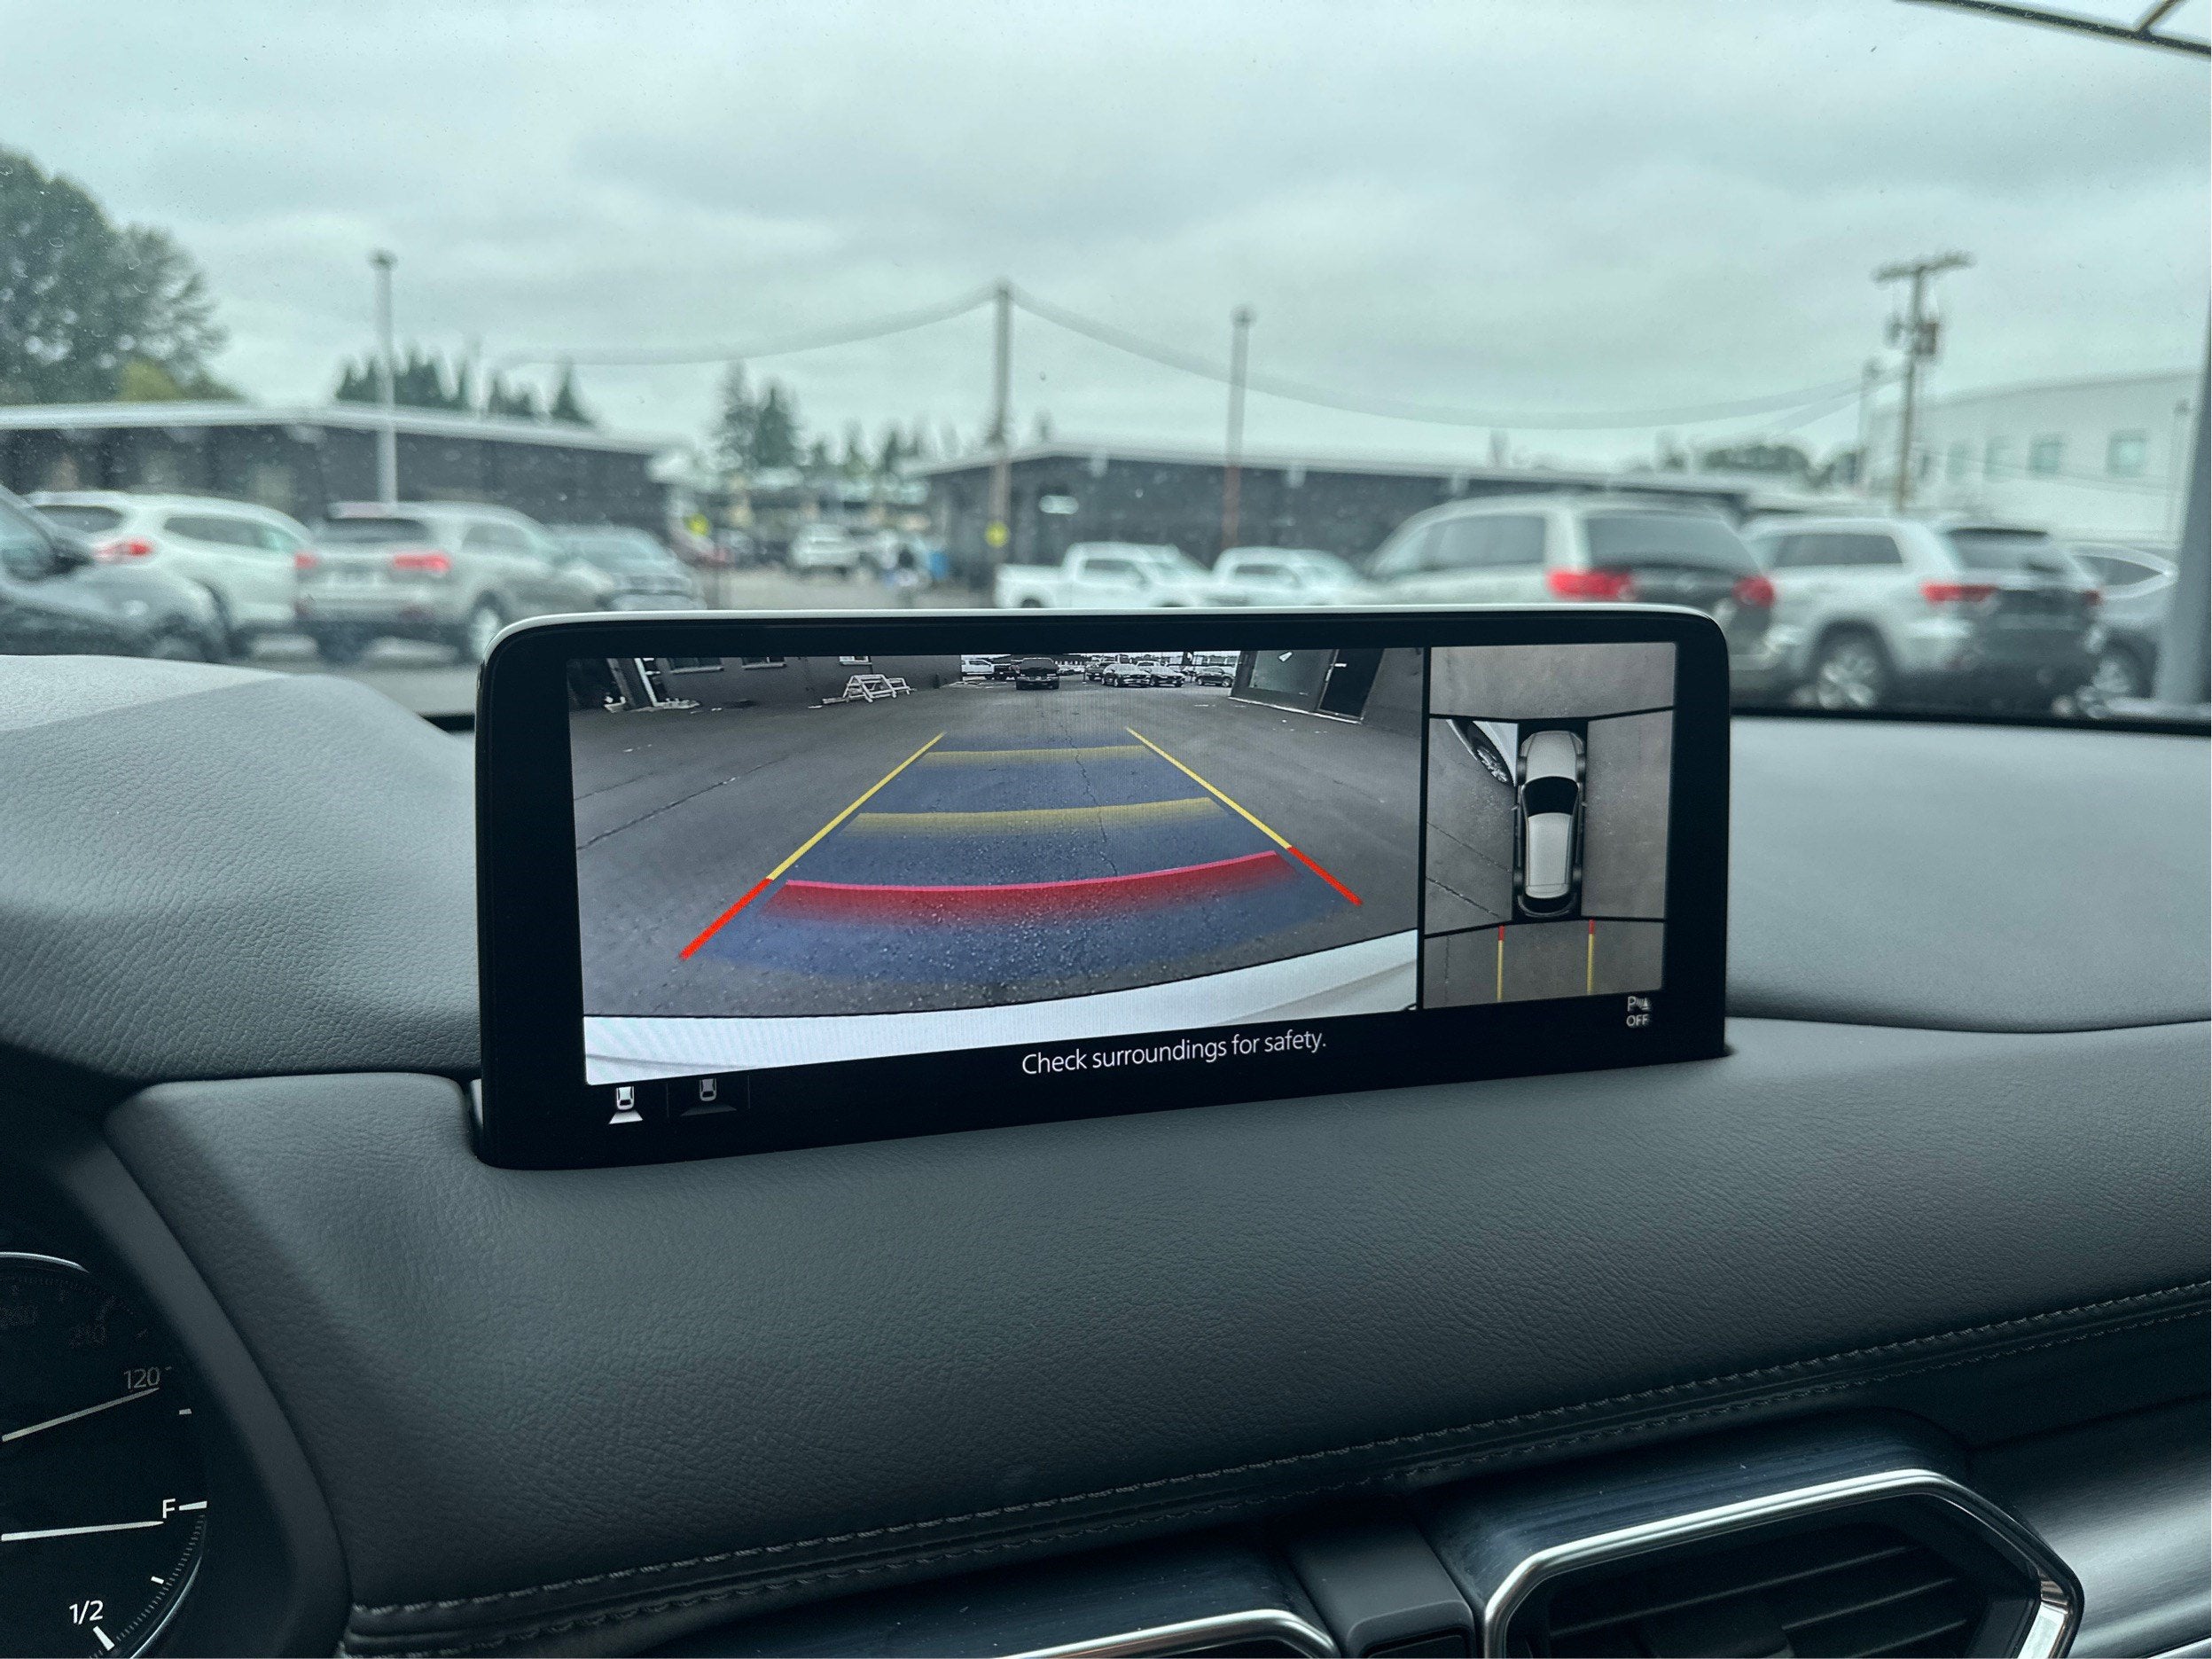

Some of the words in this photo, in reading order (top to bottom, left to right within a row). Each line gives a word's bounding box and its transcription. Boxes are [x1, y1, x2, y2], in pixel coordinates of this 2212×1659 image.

[1626, 1013, 1649, 1027] OFF
[1022, 1049, 1088, 1075] Check
[1092, 1039, 1227, 1068] surroundings
[1231, 1034, 1260, 1054] for
[1264, 1029, 1327, 1053] safety.
[123, 1366, 160, 1389] 120
[162, 1499, 176, 1519] F
[69, 1600, 104, 1625] 1/2
